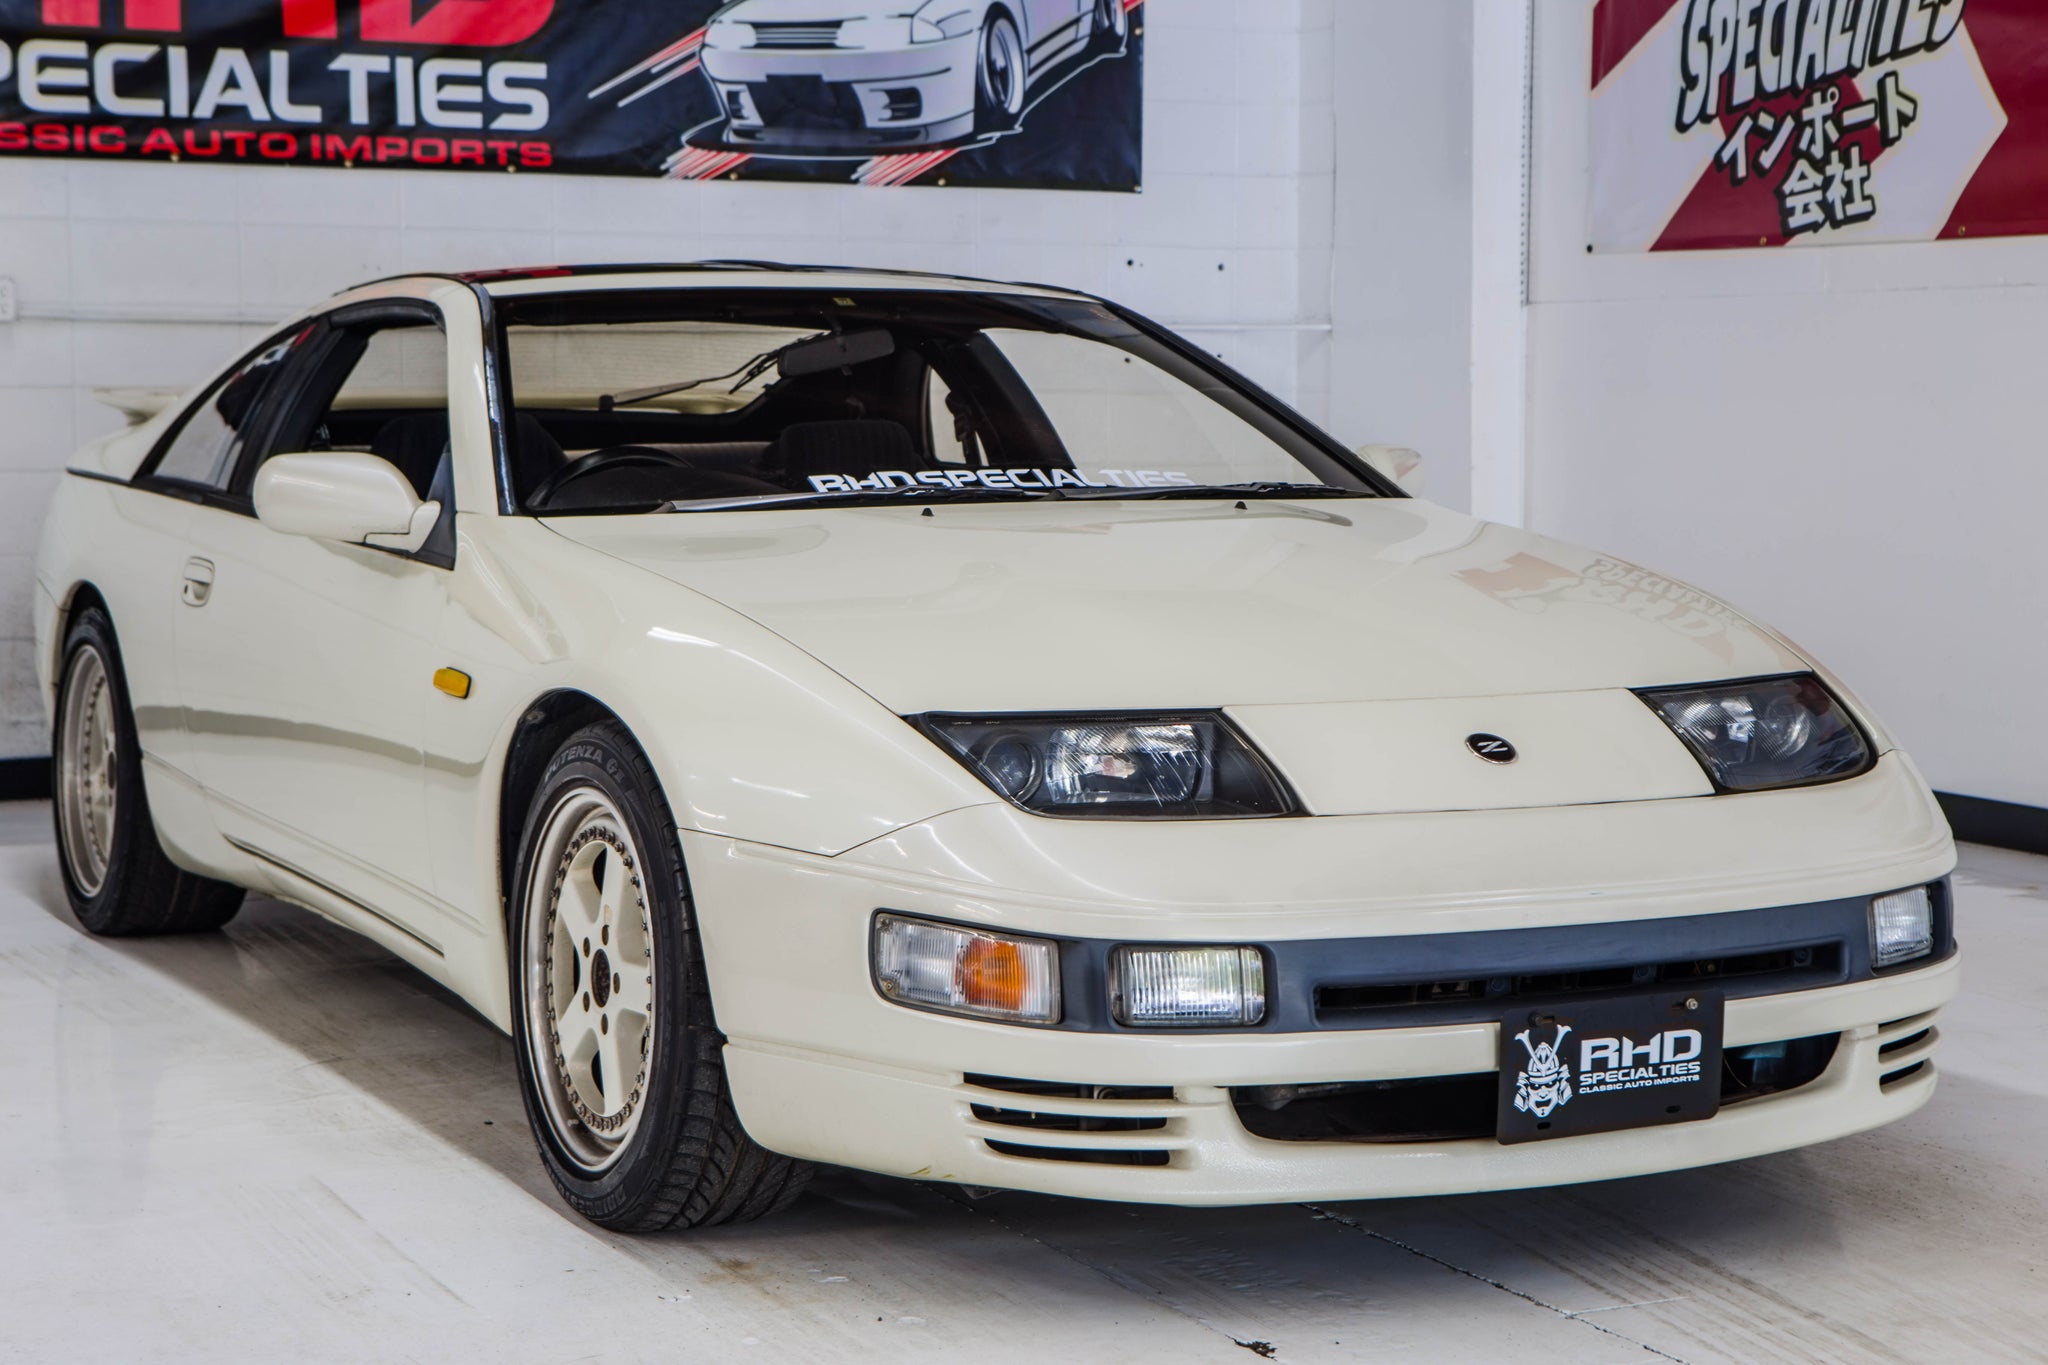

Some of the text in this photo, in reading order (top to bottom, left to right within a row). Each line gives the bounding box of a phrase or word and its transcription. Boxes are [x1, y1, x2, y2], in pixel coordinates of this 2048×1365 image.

[0, 38, 549, 131] ECIALTIES
[141, 127, 298, 160] AUTO
[310, 133, 552, 167] IMPORTS
[1716, 72, 1917, 185] インポート
[1776, 145, 1876, 235] 会社
[807, 468, 1197, 493] RHD SPECIALTIES
[1580, 1028, 1702, 1072] RHD
[1579, 1061, 1701, 1086] SPECIALTIES
[1579, 1074, 1700, 1094] CLASSIC AUTO IMPORTS
